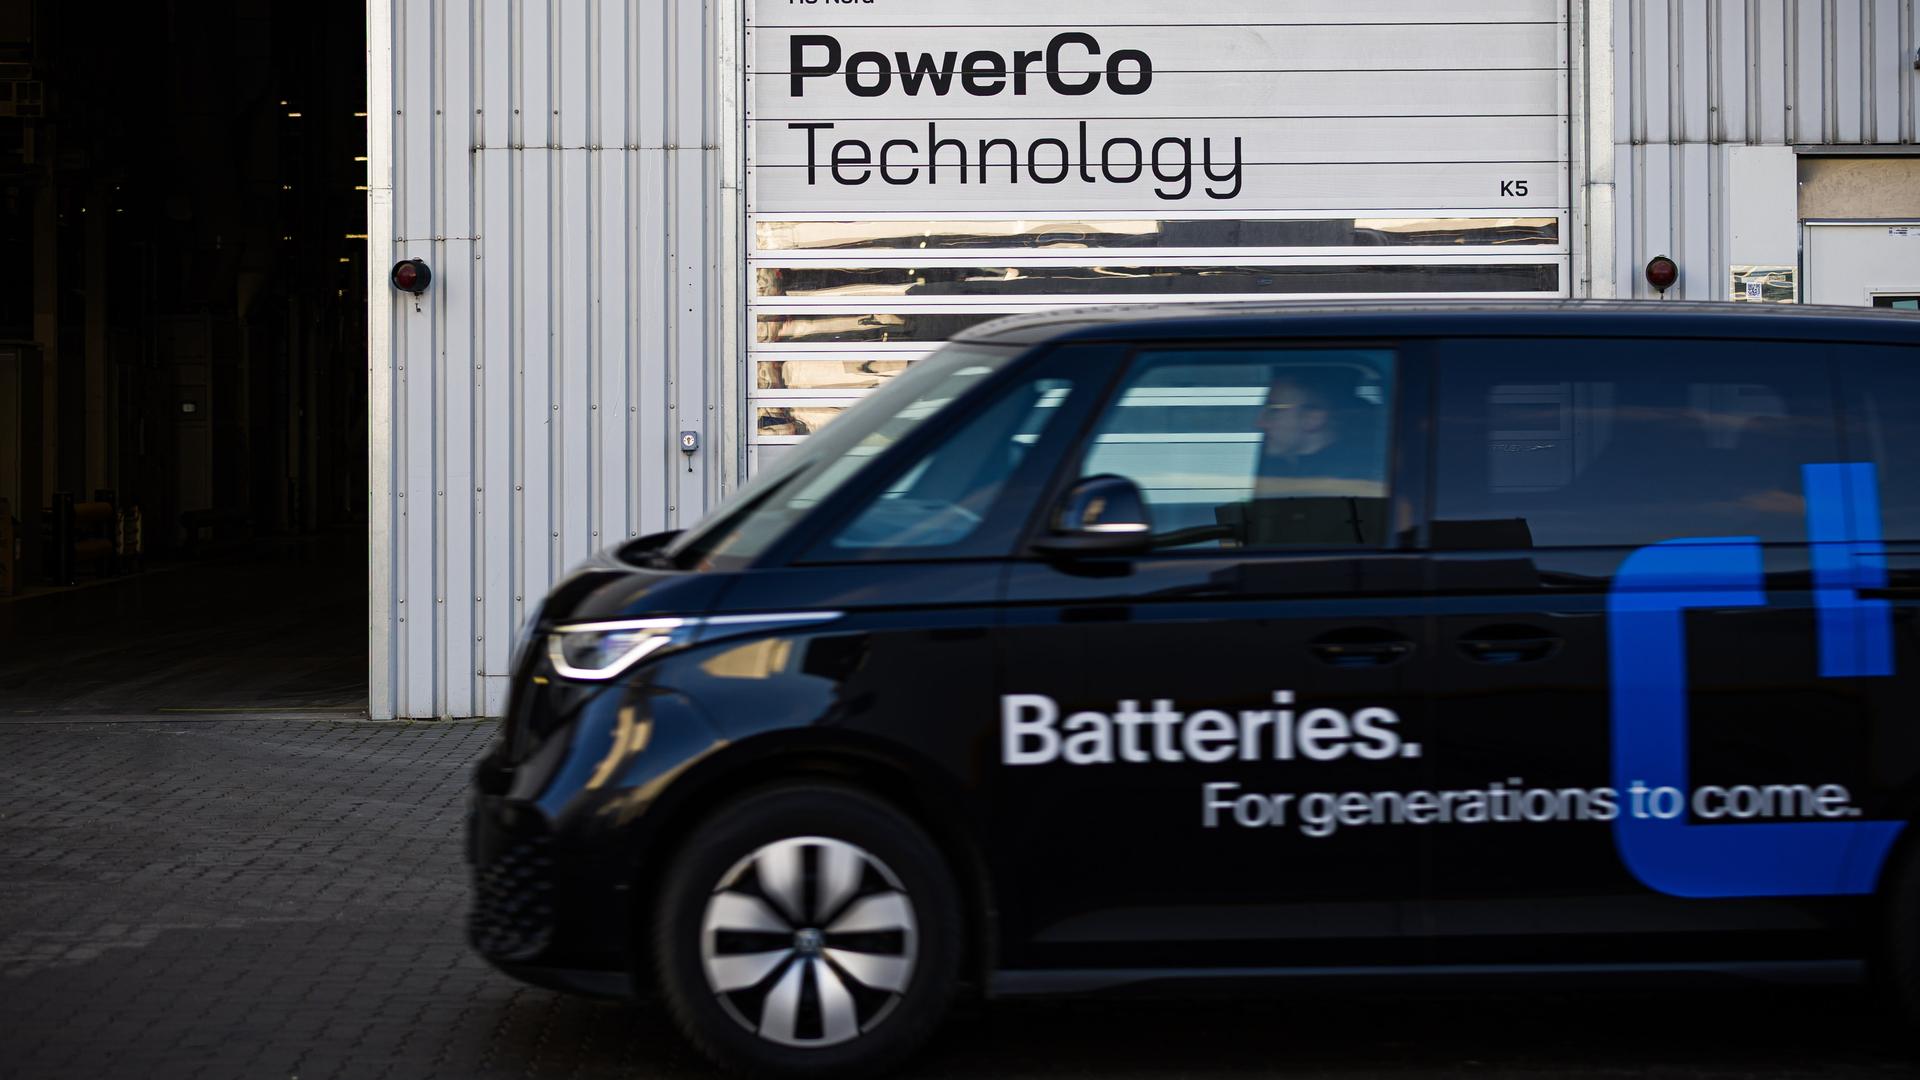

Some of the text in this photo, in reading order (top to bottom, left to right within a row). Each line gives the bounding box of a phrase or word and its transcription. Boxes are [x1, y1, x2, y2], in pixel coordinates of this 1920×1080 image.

[790, 32, 1153, 97] PowerCo
[788, 121, 1242, 200] Technology
[1500, 180, 1529, 197] K5
[1001, 690, 1421, 766] Batteries.
[1203, 777, 1863, 837] For generations to come.
